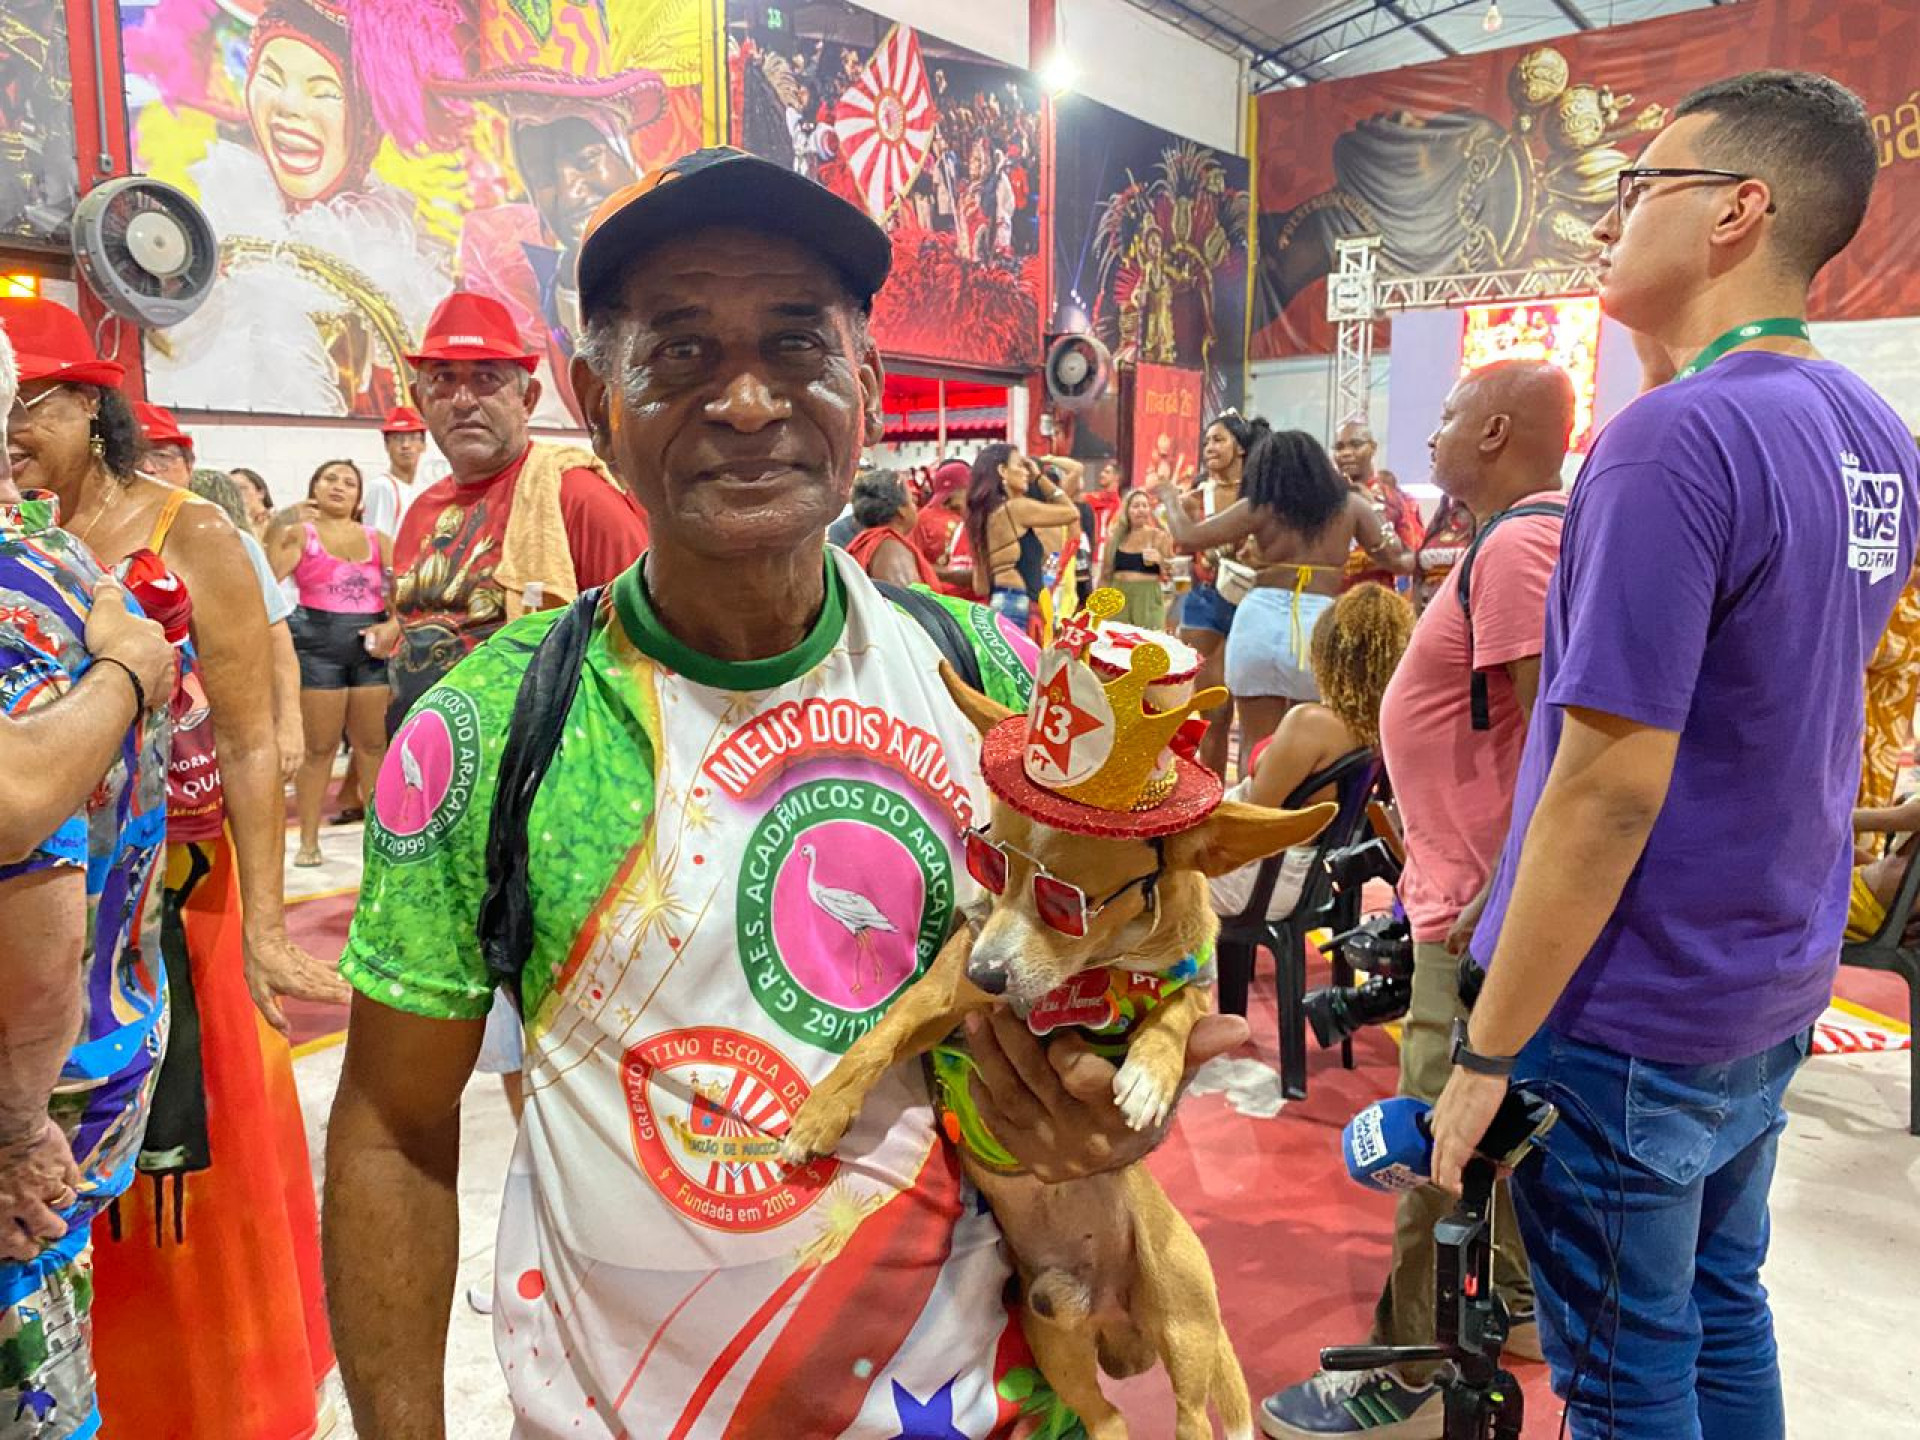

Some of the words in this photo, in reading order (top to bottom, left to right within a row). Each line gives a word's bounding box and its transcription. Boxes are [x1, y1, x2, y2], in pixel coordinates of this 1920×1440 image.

[454, 712, 474, 743] DO
[1035, 693, 1073, 746] 13
[710, 706, 803, 794] MEUS
[807, 703, 882, 752] DOIS
[1031, 750, 1051, 772] PT
[745, 783, 866, 904] ACADÊMICOS
[870, 790, 911, 829] DO
[1132, 972, 1160, 990] PT
[712, 1037, 780, 1081] ESCOLA
[675, 1183, 735, 1222] Fundada
[737, 1208, 762, 1222] em
[762, 1189, 797, 1218] 2015
